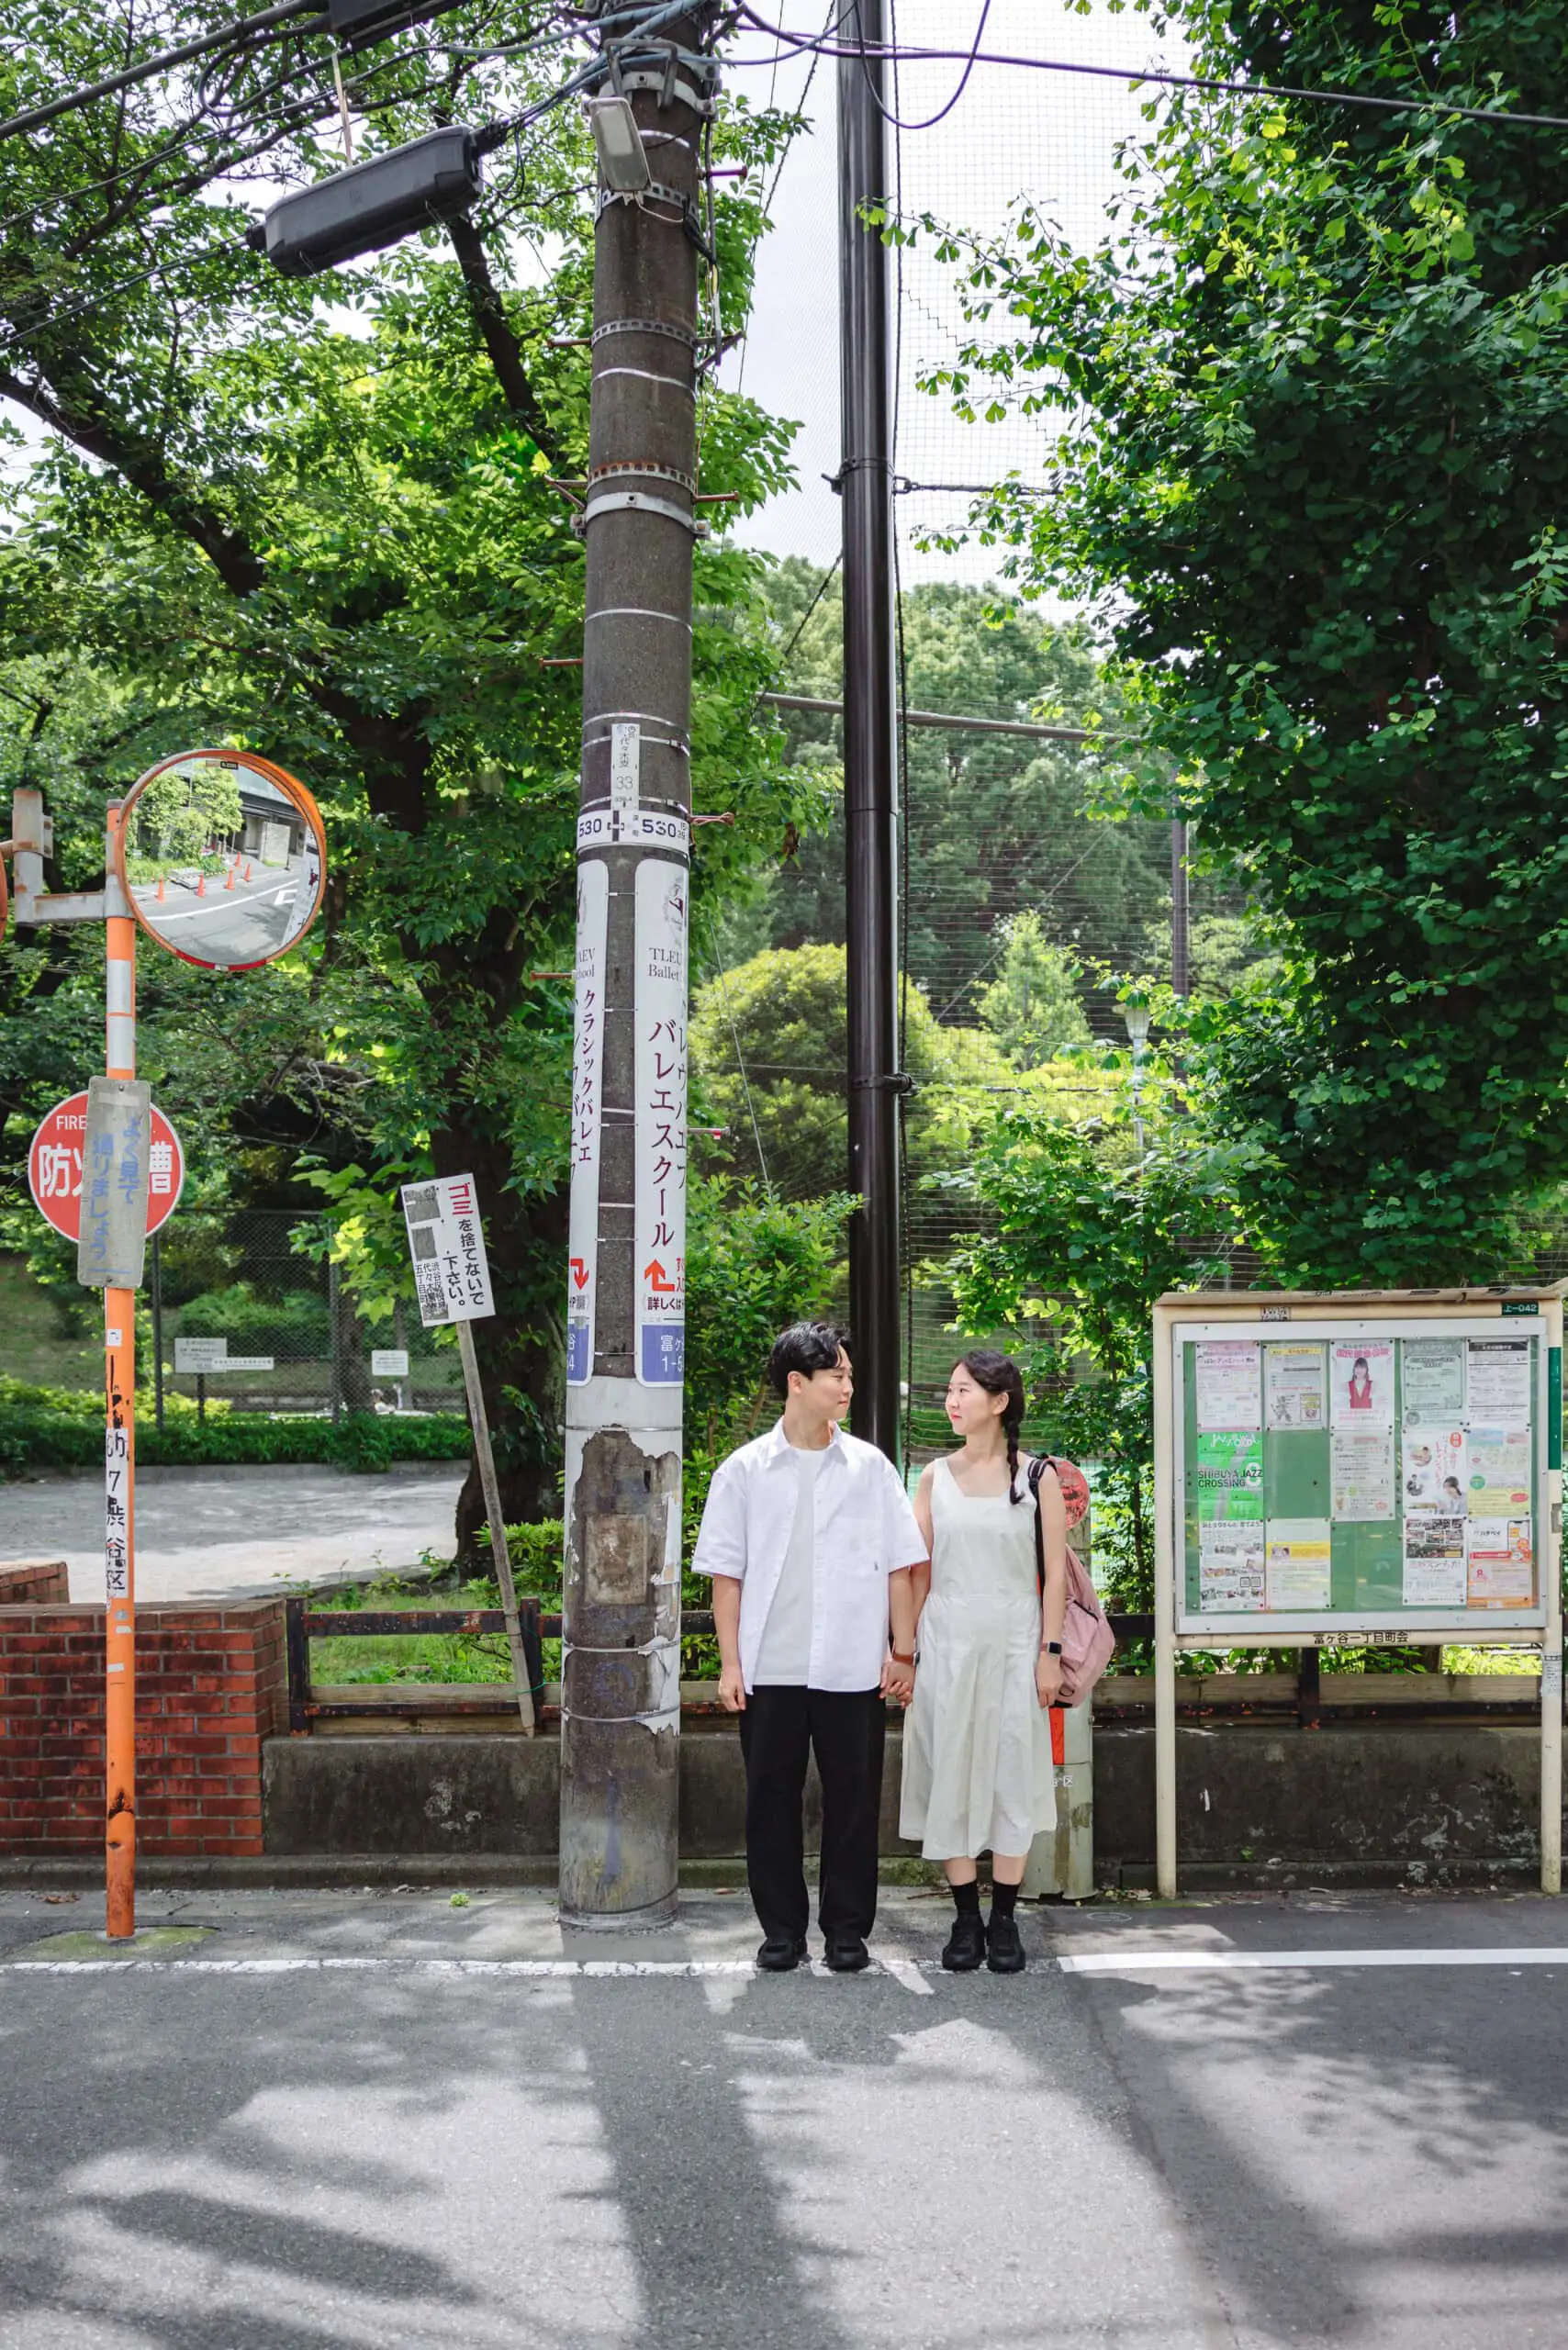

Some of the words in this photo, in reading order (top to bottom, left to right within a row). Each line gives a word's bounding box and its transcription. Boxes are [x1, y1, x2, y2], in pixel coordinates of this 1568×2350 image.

[642, 818, 677, 838] 530
[579, 990, 595, 1162] クラシックバレエ
[648, 1019, 677, 1248] バレエスクール
[1198, 1470, 1238, 1479] SHIBUYA
[1241, 1469, 1263, 1478] JAZZ
[1198, 1479, 1246, 1488] CROSSING
